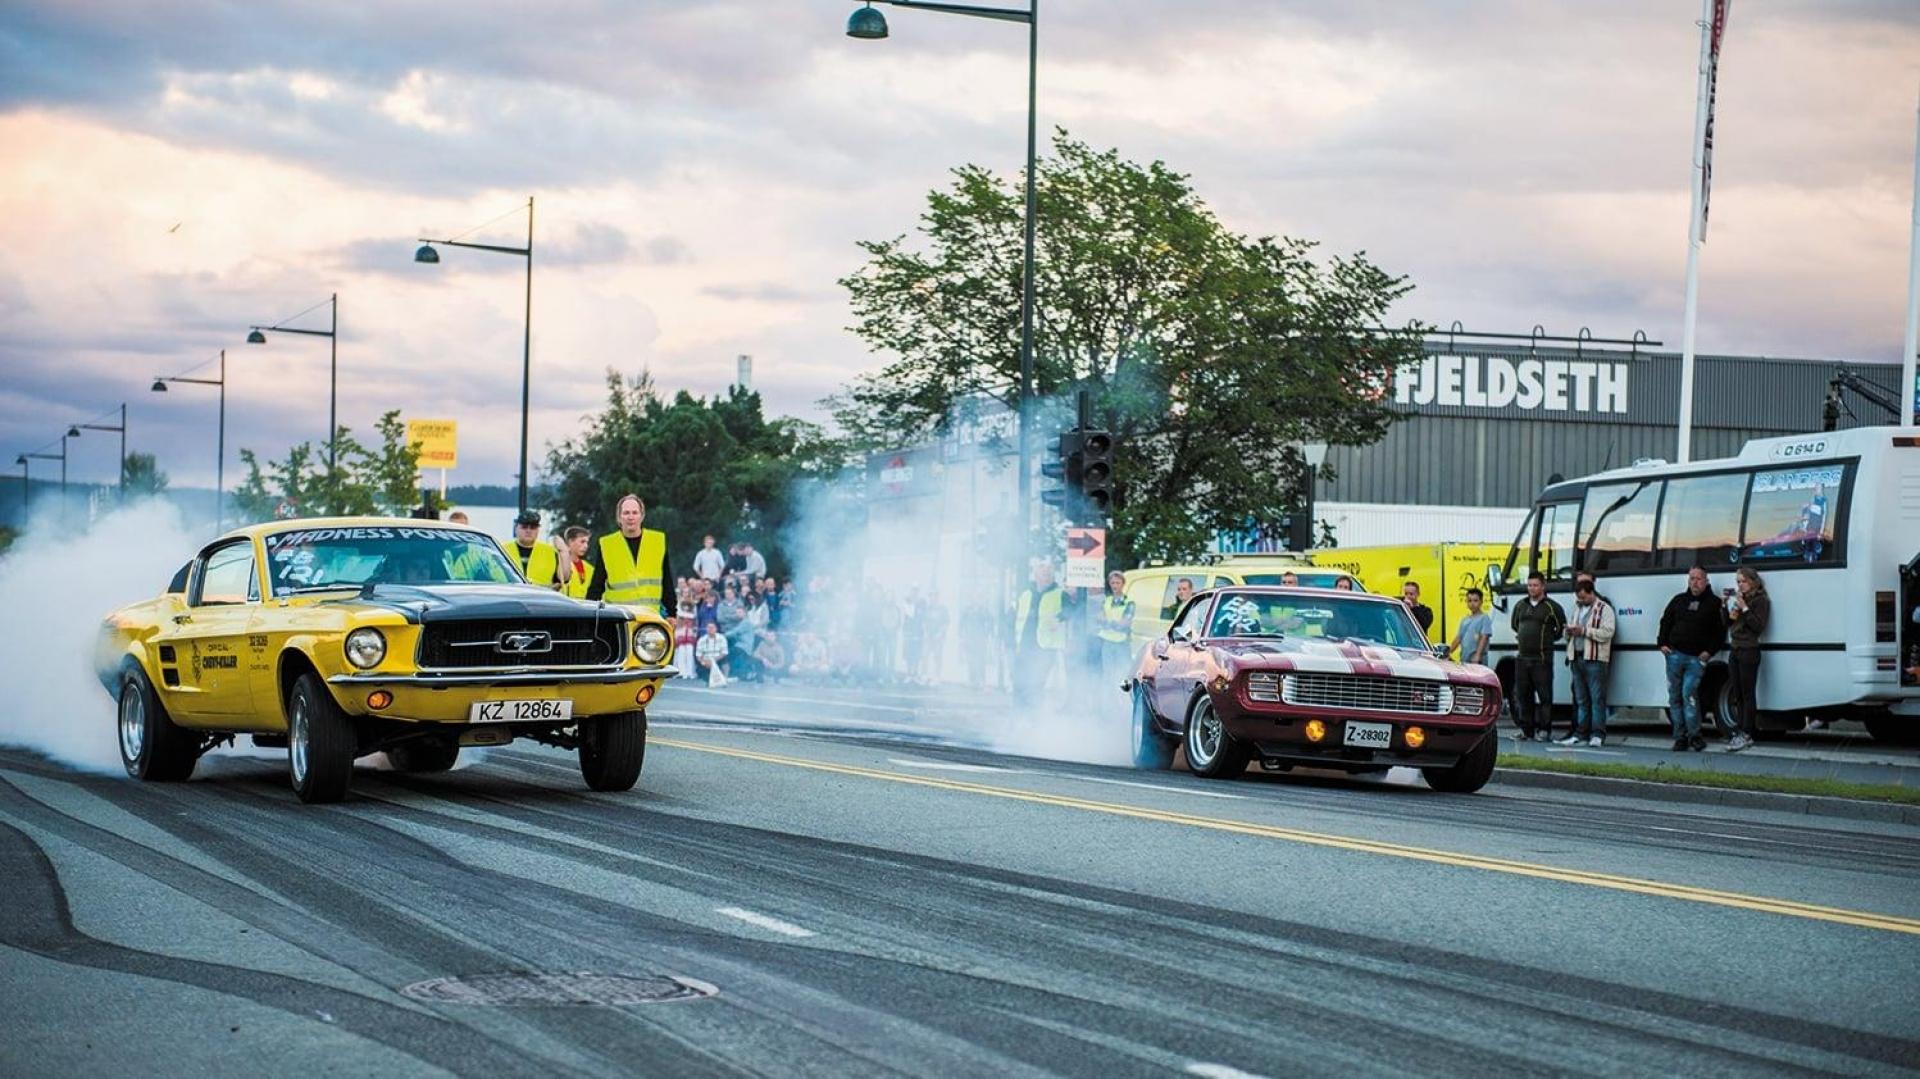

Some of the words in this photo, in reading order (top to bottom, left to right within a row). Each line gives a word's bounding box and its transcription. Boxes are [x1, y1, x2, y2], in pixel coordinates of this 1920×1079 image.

[1395, 353, 1628, 413] FJELDSETH
[272, 528, 394, 551] MADNESS
[480, 703, 504, 720] KZ
[514, 702, 562, 719] 12864
